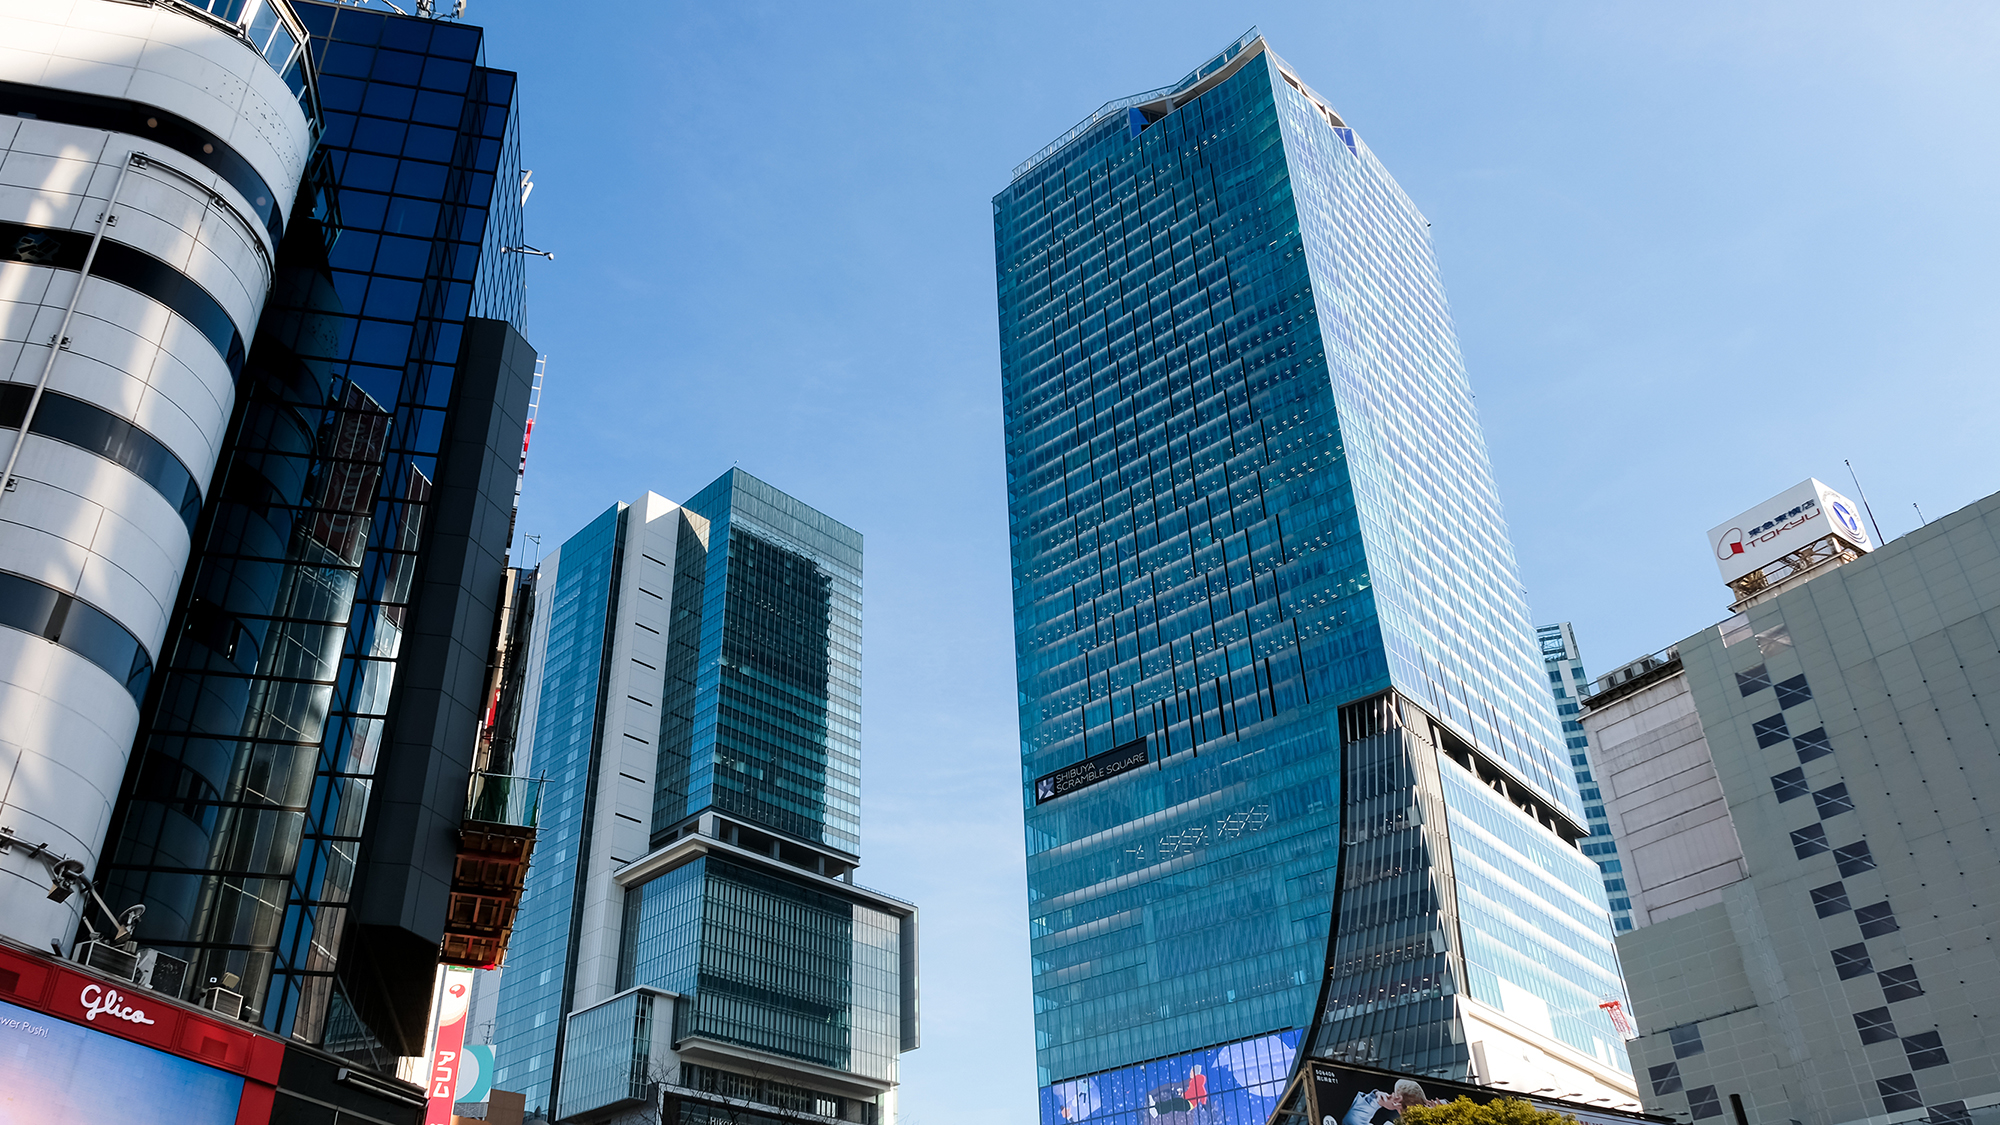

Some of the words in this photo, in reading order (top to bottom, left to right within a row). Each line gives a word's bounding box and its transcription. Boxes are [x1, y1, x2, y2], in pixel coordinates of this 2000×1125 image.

[1745, 508, 1820, 547] TOKYU
[1056, 762, 1095, 783] SHIBUYA
[1056, 768, 1104, 793] SCRAMBLE
[1106, 752, 1145, 774] SQUARE
[81, 984, 155, 1025] Glico
[22, 1021, 49, 1038] Push!
[433, 1051, 456, 1098] アコム
